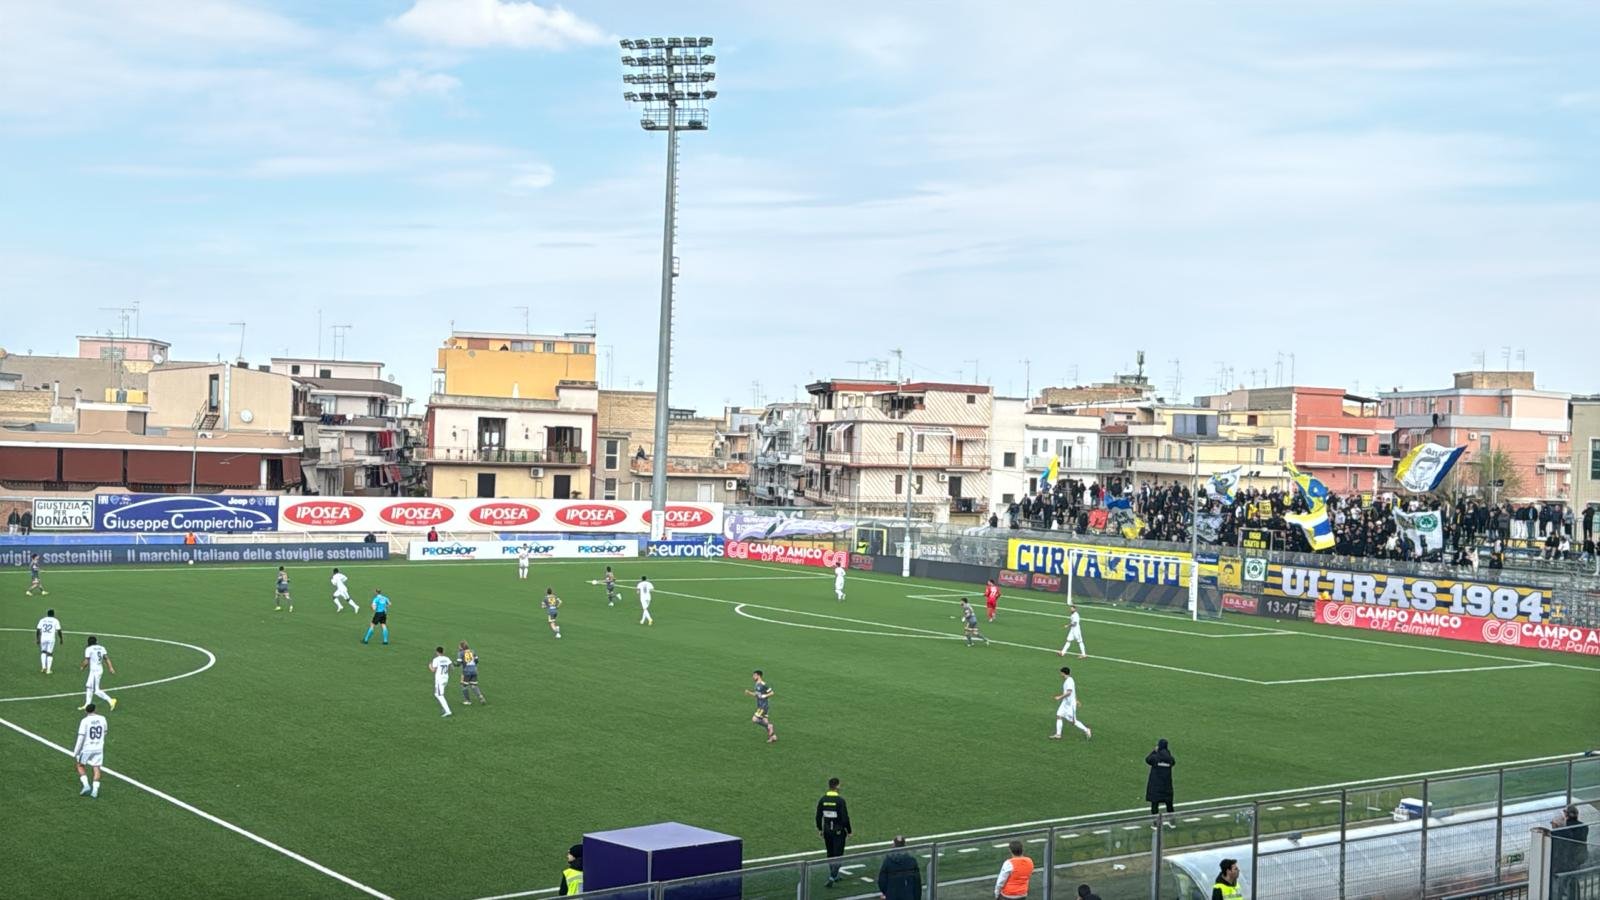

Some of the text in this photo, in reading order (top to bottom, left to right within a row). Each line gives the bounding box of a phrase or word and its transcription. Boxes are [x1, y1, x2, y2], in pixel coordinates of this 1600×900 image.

[37, 502, 80, 510] GIUSTIZIA
[296, 506, 350, 519] IPOSEA
[390, 507, 442, 520] IPOSEA
[480, 508, 529, 520] IPOSEA
[565, 509, 615, 521] IPOSEA
[37, 516, 81, 525] DONATO
[103, 513, 254, 530] Giuseppe Compierchio
[139, 549, 190, 562] marchio
[193, 548, 240, 561] Italiano
[243, 546, 271, 560] delle
[274, 546, 324, 561] stoviglie
[327, 546, 383, 559] sostenibili
[422, 546, 477, 556] PROSHOP
[578, 545, 626, 555] PROSHOP
[659, 541, 724, 557] euronics
[749, 543, 822, 559] CAMPO AMICO
[43, 550, 112, 563] sostenibili
[1017, 544, 1181, 586] CURVA SUD
[1266, 601, 1298, 615] 13:47
[1448, 583, 1543, 622] 1984
[1357, 606, 1462, 628] CAMPO AMICO
[43, 624, 53, 633] 32
[1521, 623, 1582, 641] CAMPO
[90, 725, 103, 740] 69
